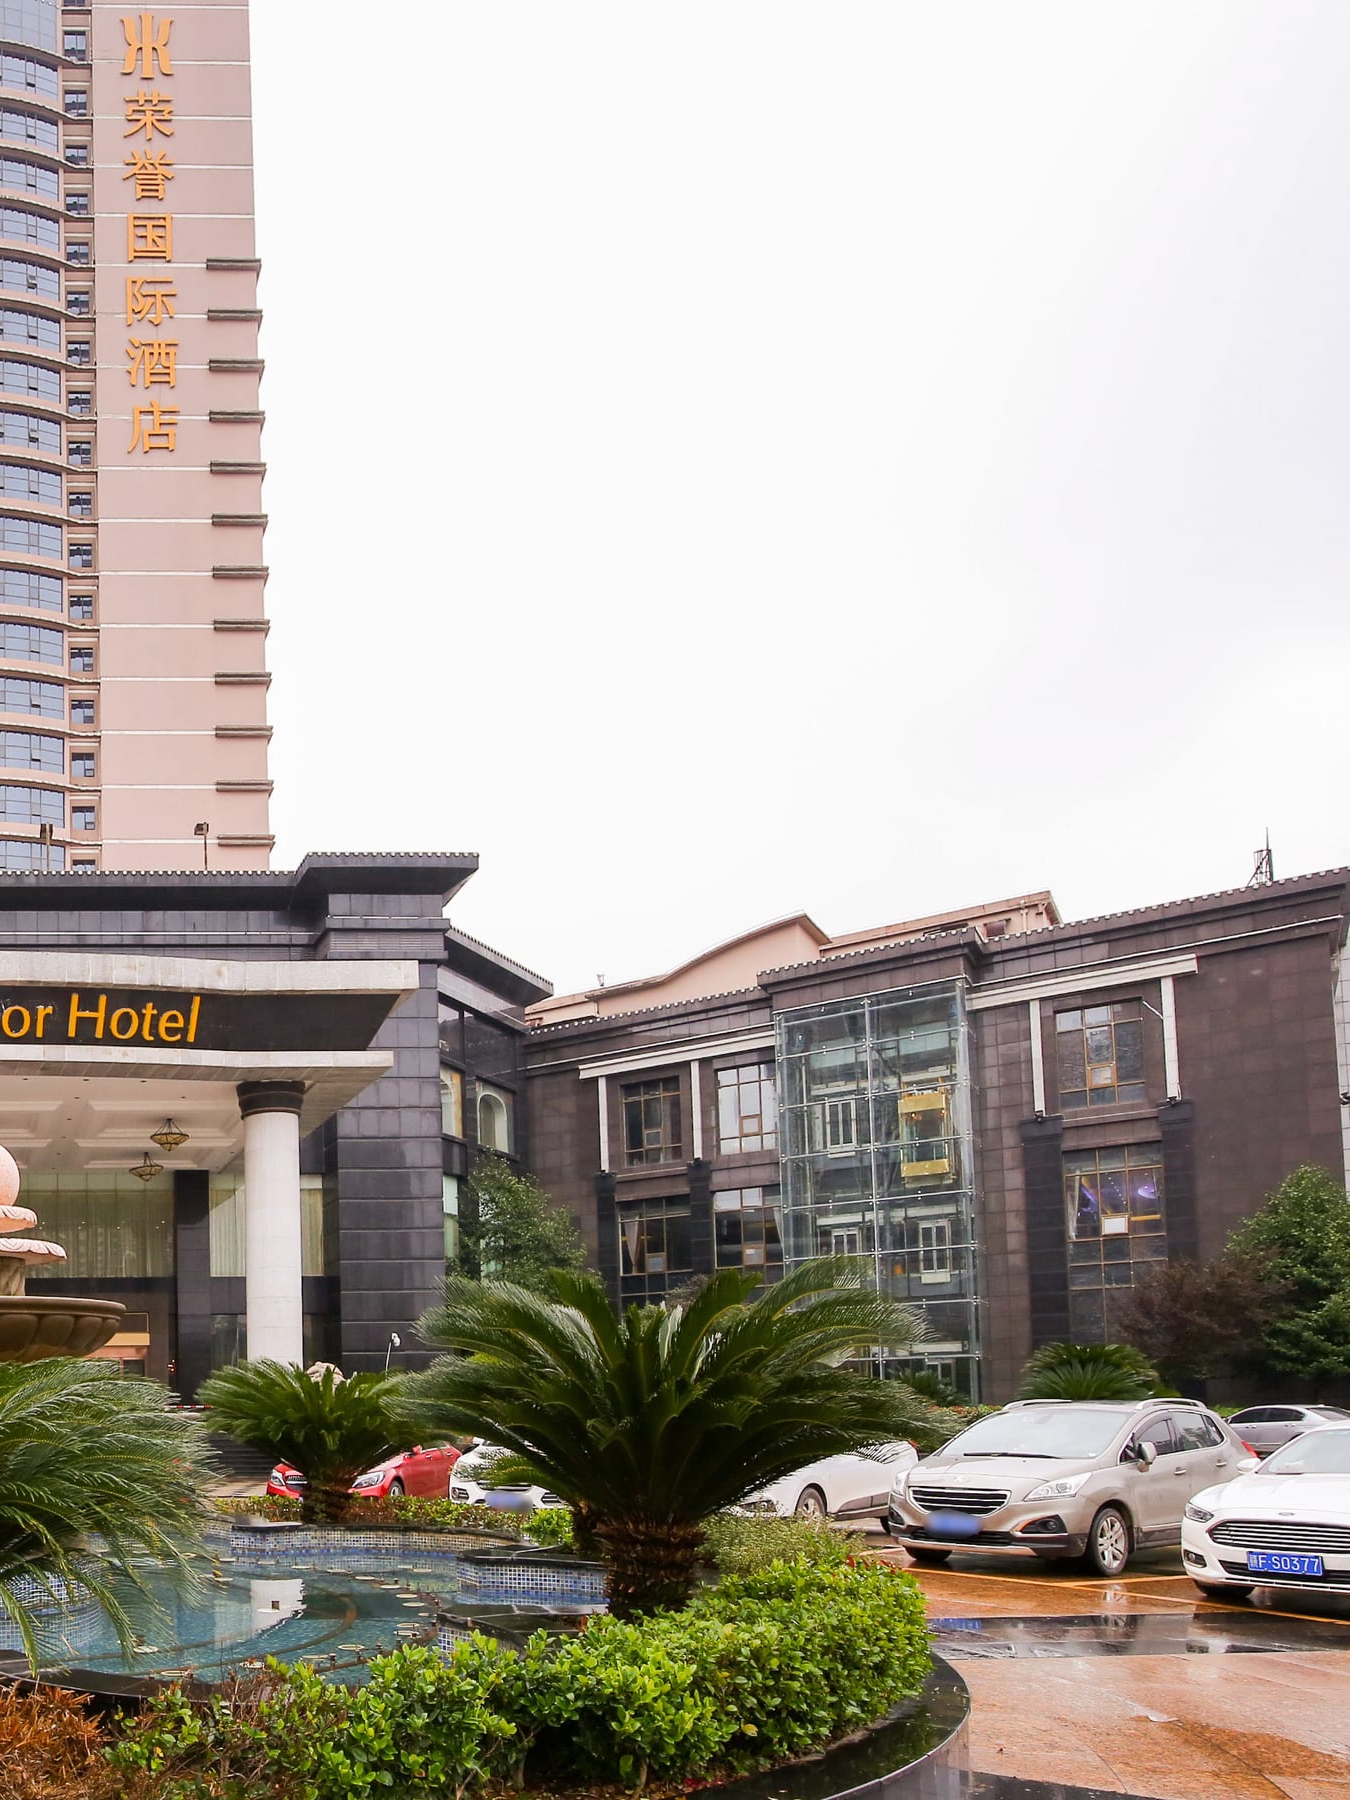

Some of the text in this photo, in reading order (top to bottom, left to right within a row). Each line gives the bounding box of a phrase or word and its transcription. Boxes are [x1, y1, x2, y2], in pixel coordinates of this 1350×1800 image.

[123, 90, 179, 453] 荣誉国际酒店
[67, 993, 202, 1042] Hotel
